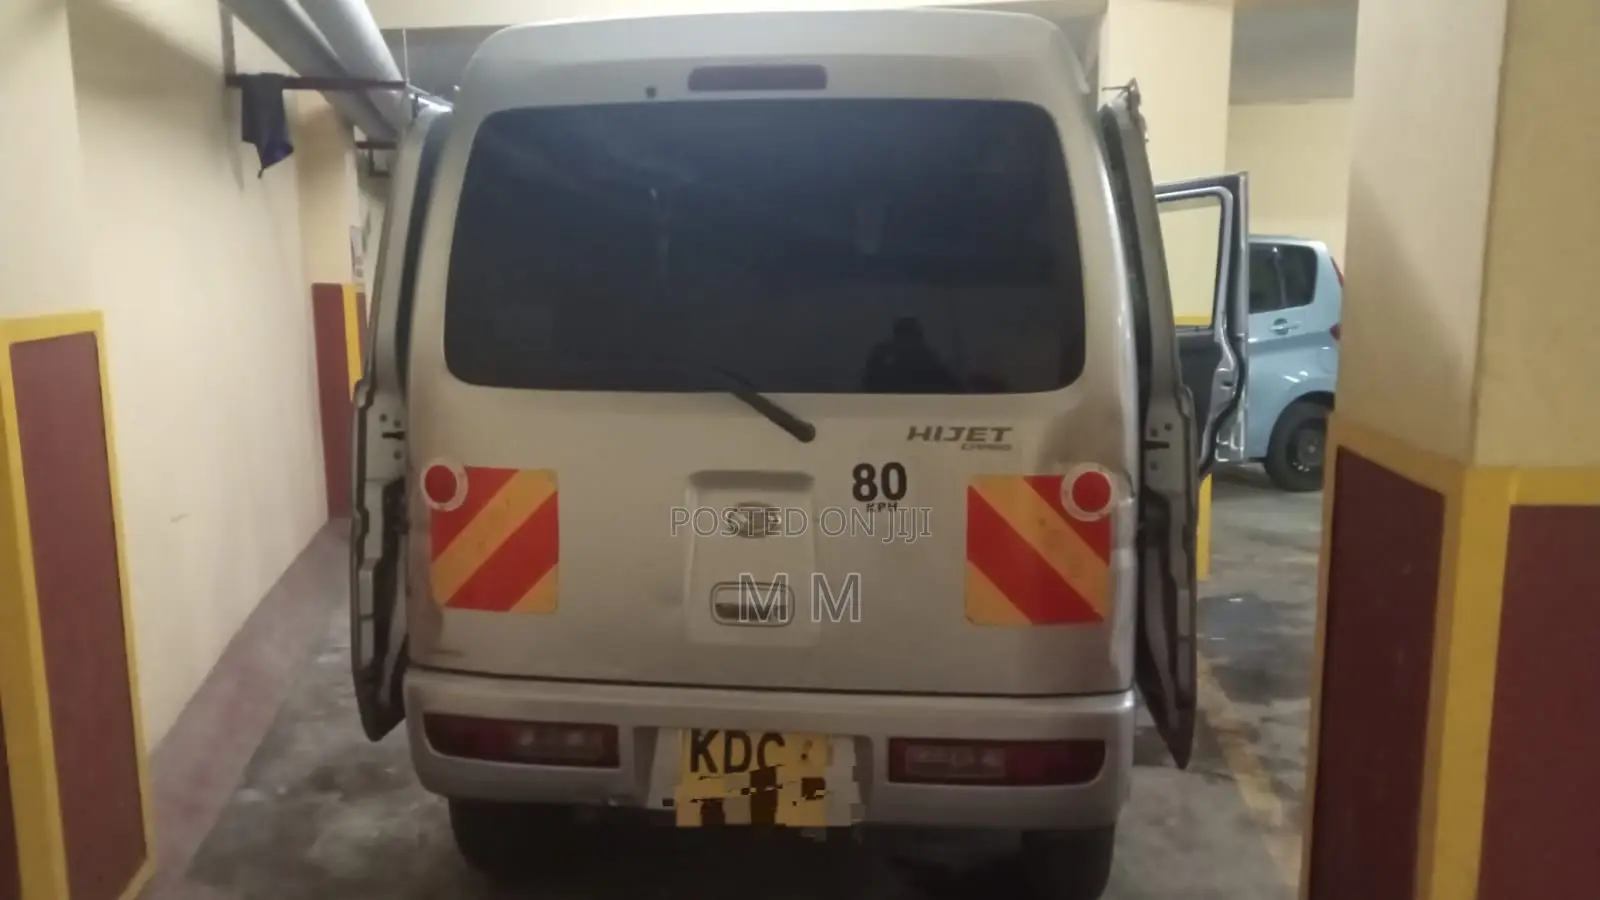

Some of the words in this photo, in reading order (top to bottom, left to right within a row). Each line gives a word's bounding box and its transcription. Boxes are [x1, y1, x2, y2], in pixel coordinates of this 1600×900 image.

[907, 426, 1013, 442] HIJET
[852, 462, 907, 502] 80
[866, 502, 898, 513] KPH
